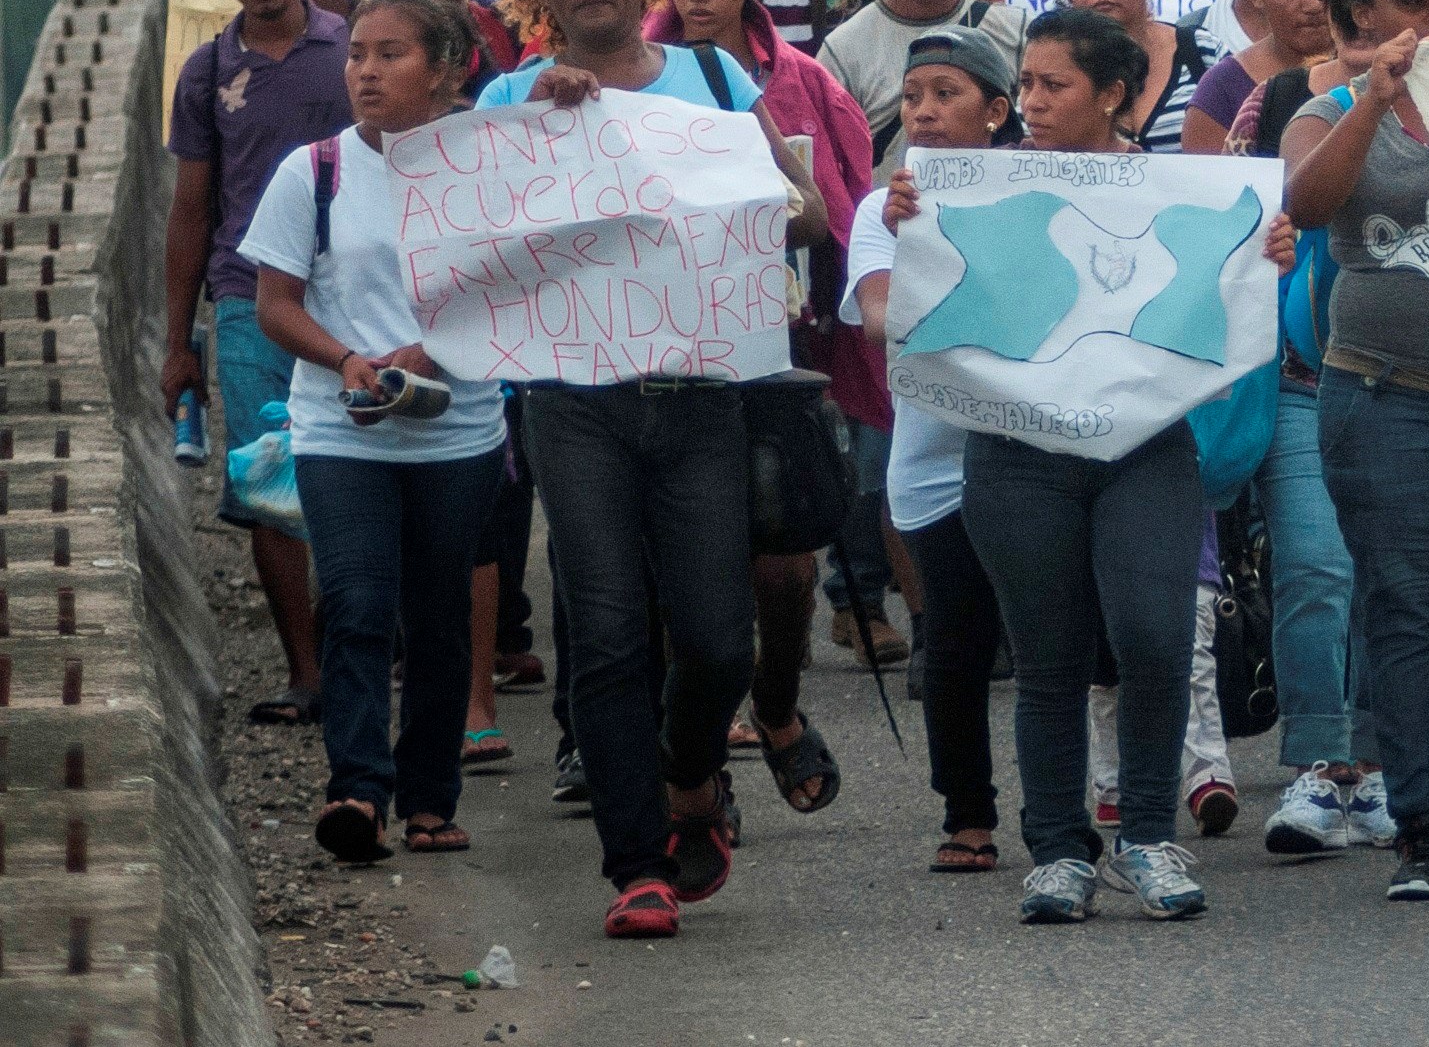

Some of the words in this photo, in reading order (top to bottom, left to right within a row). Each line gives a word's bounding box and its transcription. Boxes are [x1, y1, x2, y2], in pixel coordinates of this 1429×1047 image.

[625, 202, 787, 272] MEXICO
[482, 264, 788, 343] HONDURAS
[484, 340, 532, 380] X
[553, 339, 740, 385] FAVOR
